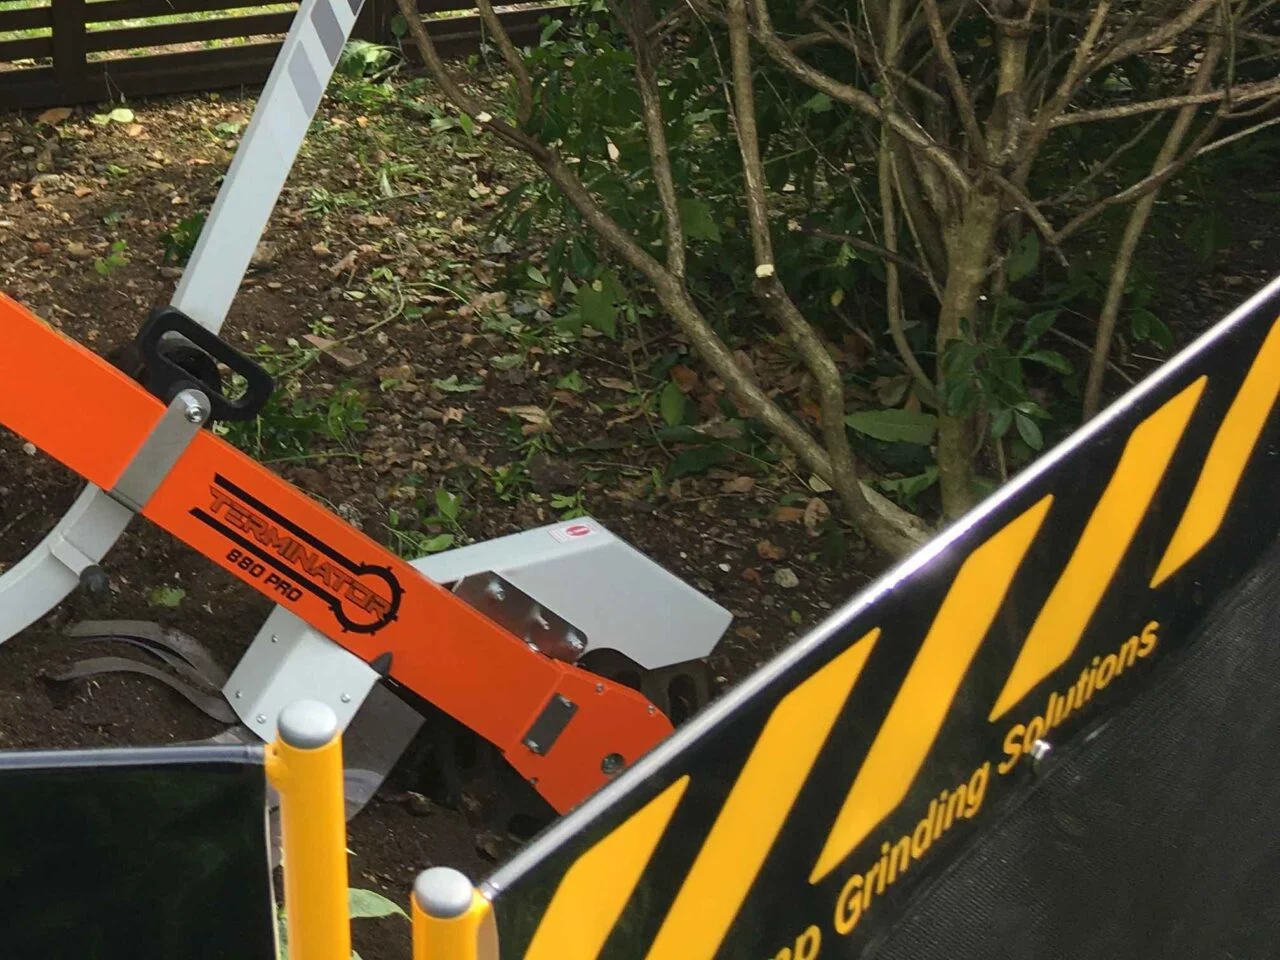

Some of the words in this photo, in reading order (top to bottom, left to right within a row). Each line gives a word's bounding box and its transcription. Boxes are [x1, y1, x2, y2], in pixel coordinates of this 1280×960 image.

[209, 486, 391, 620] TERMINATOR
[226, 548, 265, 578] 880
[264, 573, 303, 602] PRO
[834, 761, 990, 934] Grinding
[998, 621, 1159, 774] Solutions
